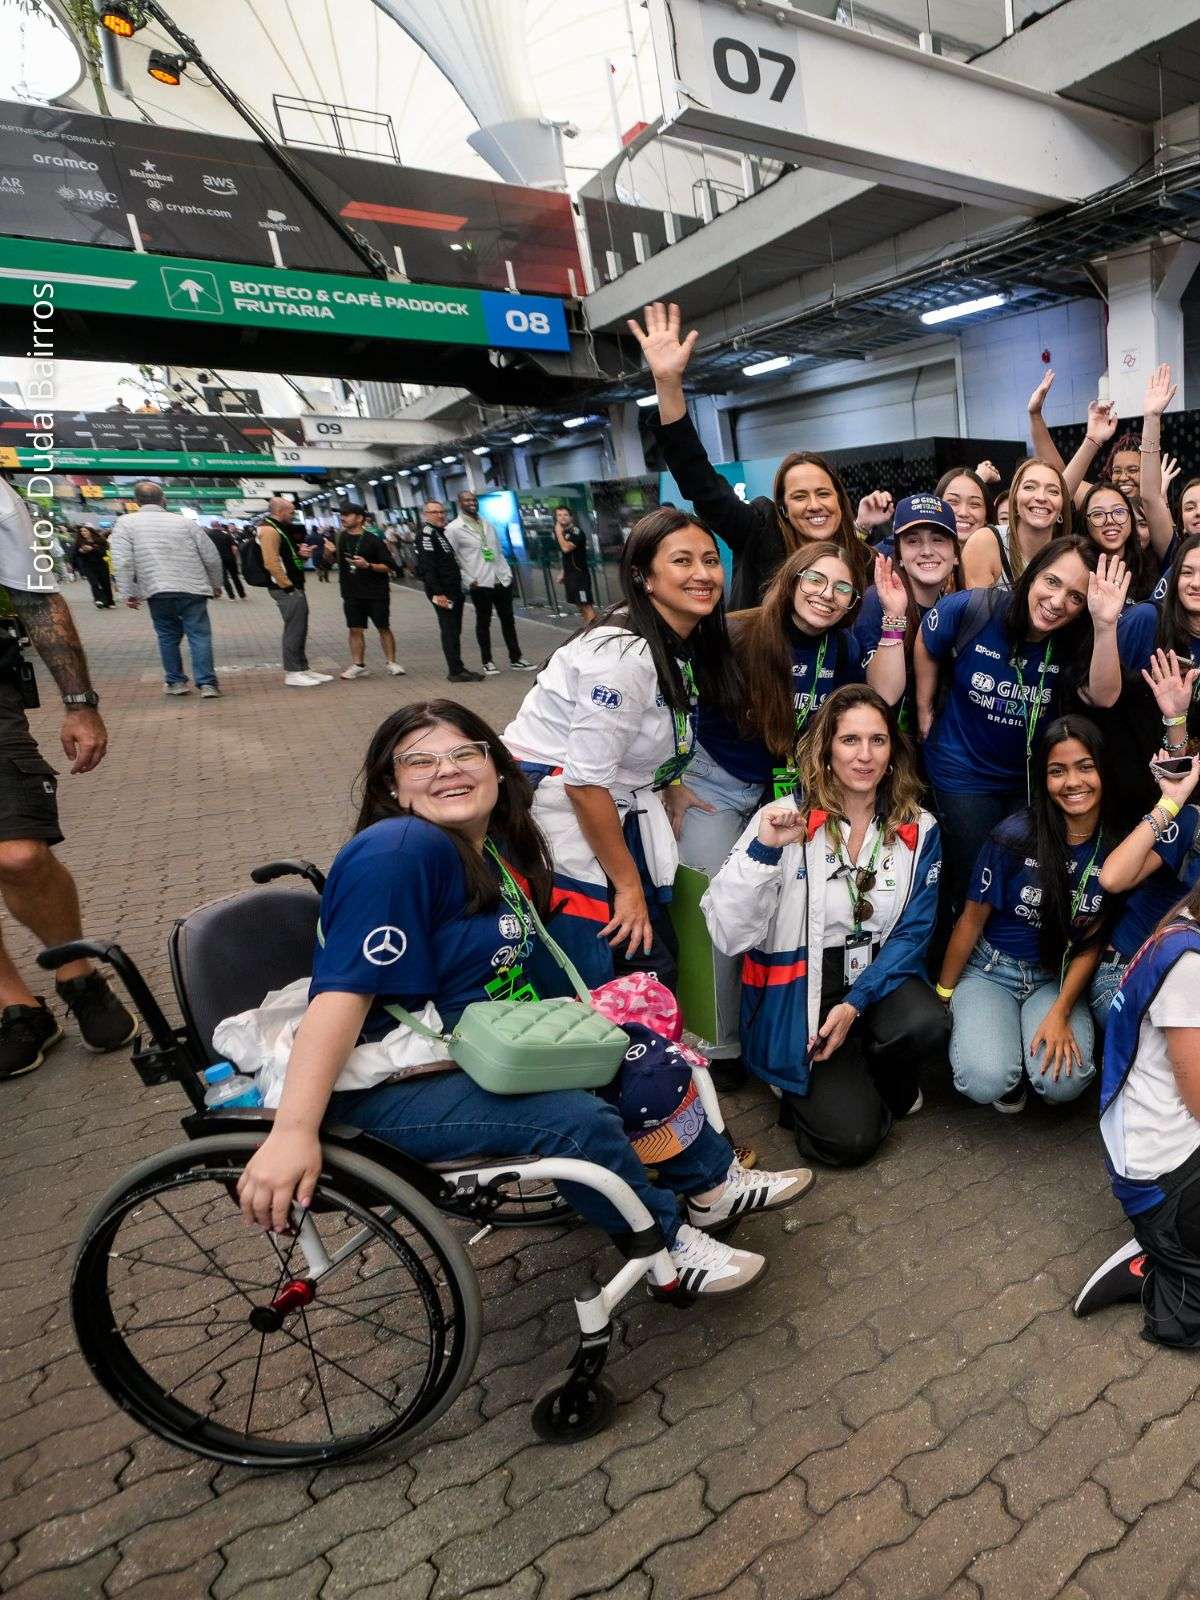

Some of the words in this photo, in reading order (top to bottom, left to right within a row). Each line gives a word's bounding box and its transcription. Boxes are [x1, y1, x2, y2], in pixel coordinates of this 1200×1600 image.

[712, 37, 796, 103] 07
[32, 153, 99, 171] aramco
[201, 174, 235, 189] aws
[77, 188, 118, 204] MSC
[166, 202, 232, 220] crypto.com
[229, 280, 313, 302] BOTECO
[315, 289, 331, 303] &
[332, 291, 382, 308] CAFÉ
[384, 297, 470, 316] PADDOCK
[233, 298, 336, 320] FRUTARIA
[505, 309, 551, 335] 08
[316, 422, 343, 435] 09
[282, 452, 301, 462] 10
[981, 647, 1001, 660] Porto
[591, 685, 622, 709] FIA
[971, 672, 995, 693] FIA
[997, 681, 1053, 704] GIRLS
[987, 713, 1024, 728] BRASIL
